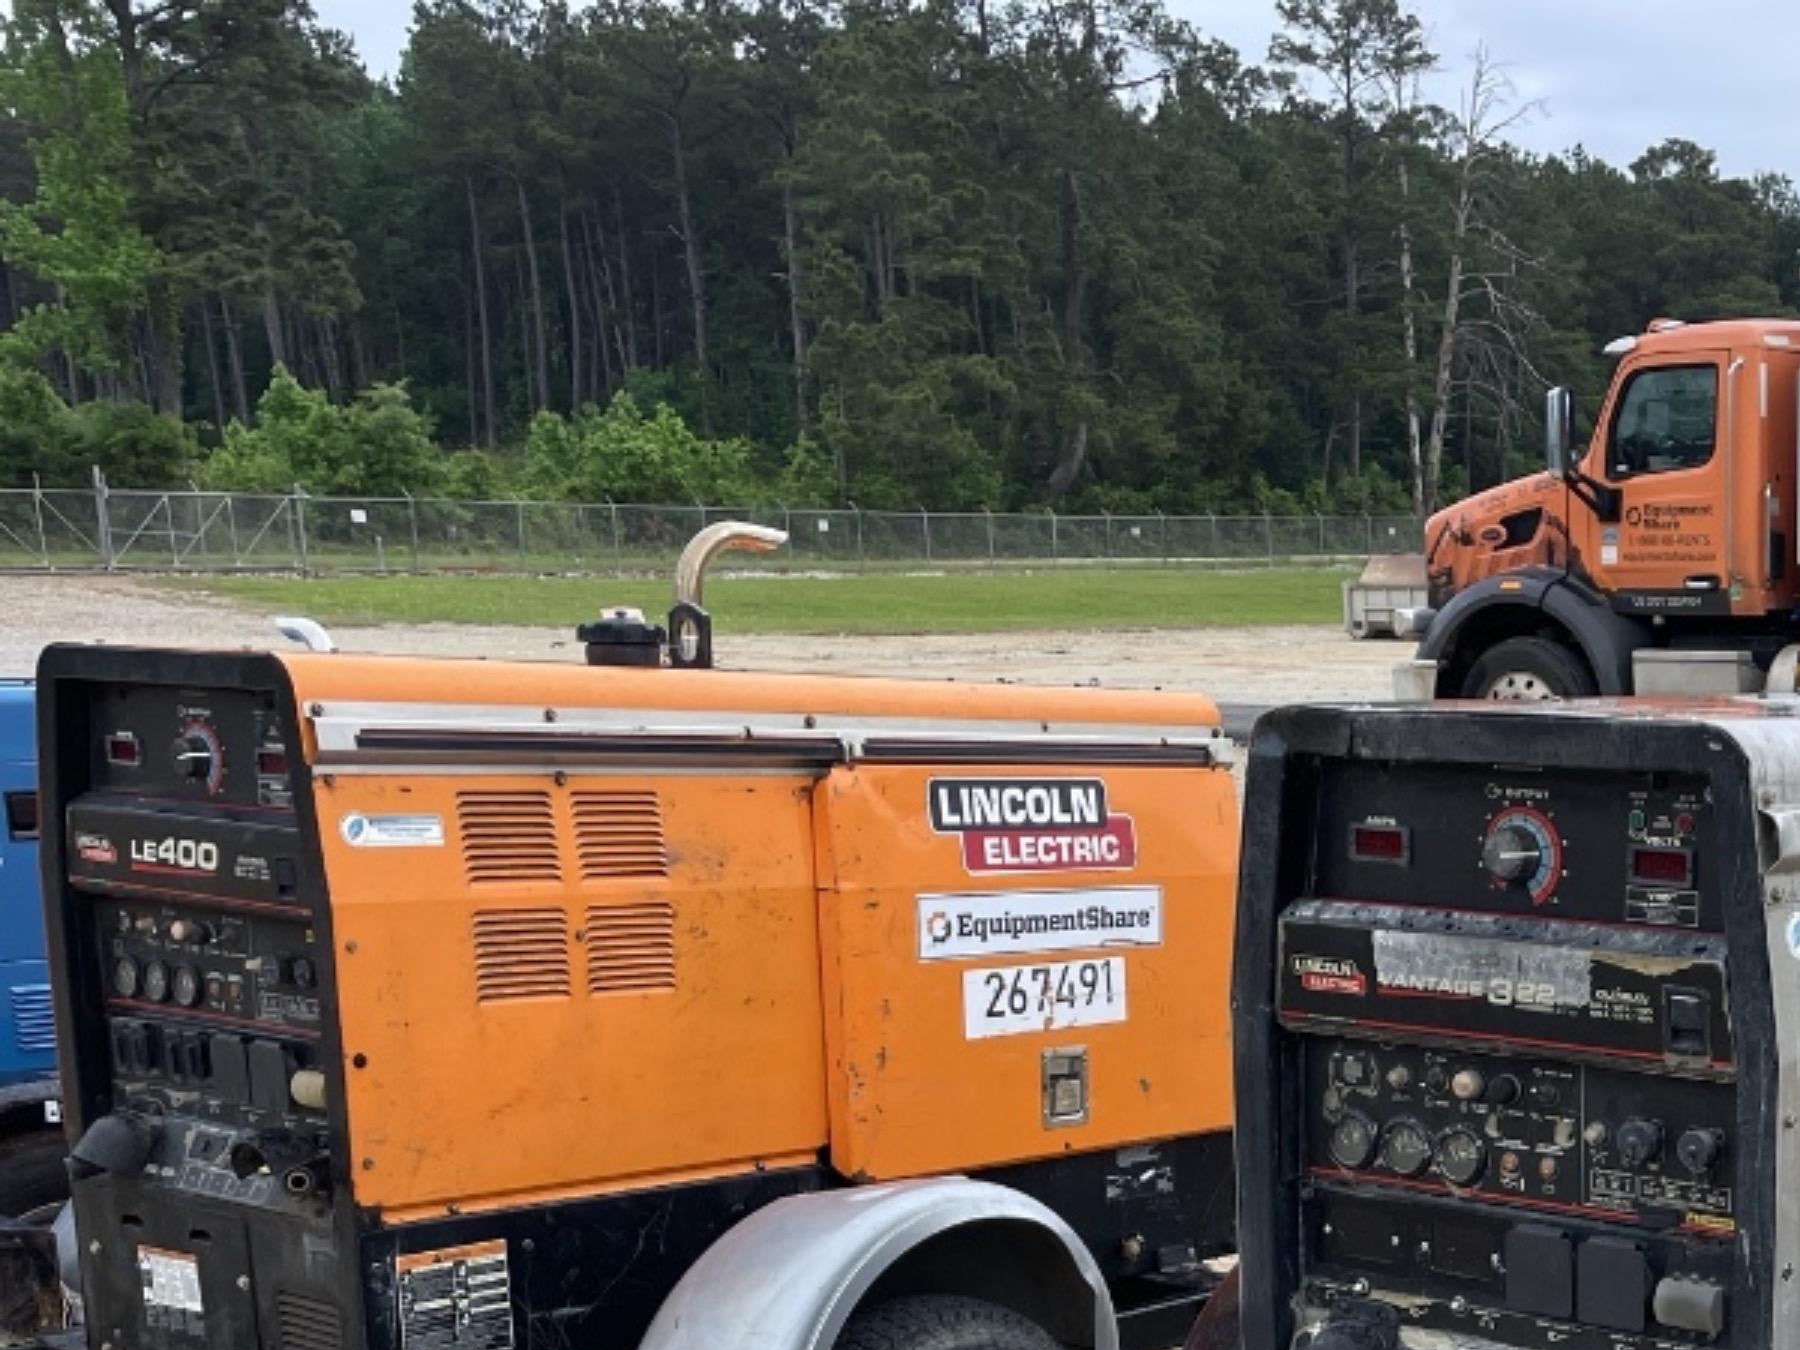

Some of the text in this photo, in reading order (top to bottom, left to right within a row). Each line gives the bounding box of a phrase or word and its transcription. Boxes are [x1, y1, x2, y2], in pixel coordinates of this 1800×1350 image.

[938, 785, 1099, 825] LINCOLN
[131, 837, 217, 871] LE400
[983, 835, 1120, 865] ELECTRIC
[957, 906, 1150, 942] EquipmentShare
[984, 960, 1114, 1018] 267491
[1377, 972, 1483, 996] VANTAGE
